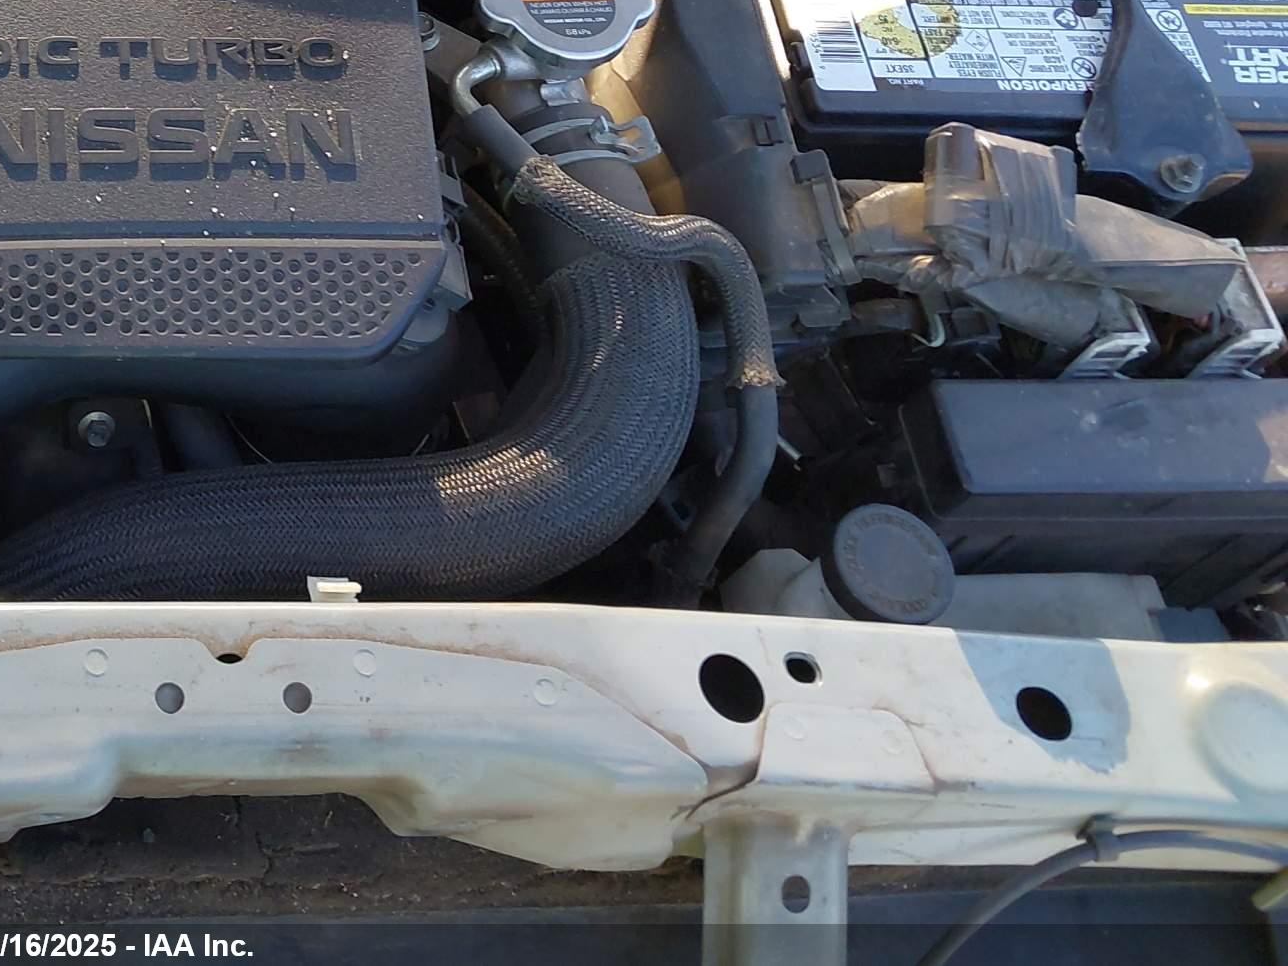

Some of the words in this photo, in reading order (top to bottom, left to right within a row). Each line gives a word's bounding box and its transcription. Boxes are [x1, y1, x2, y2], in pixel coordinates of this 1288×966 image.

[99, 37, 348, 79] TURBO
[1228, 48, 1288, 66] ART
[884, 65, 915, 74] 35EXT
[1233, 66, 1288, 84] PER
